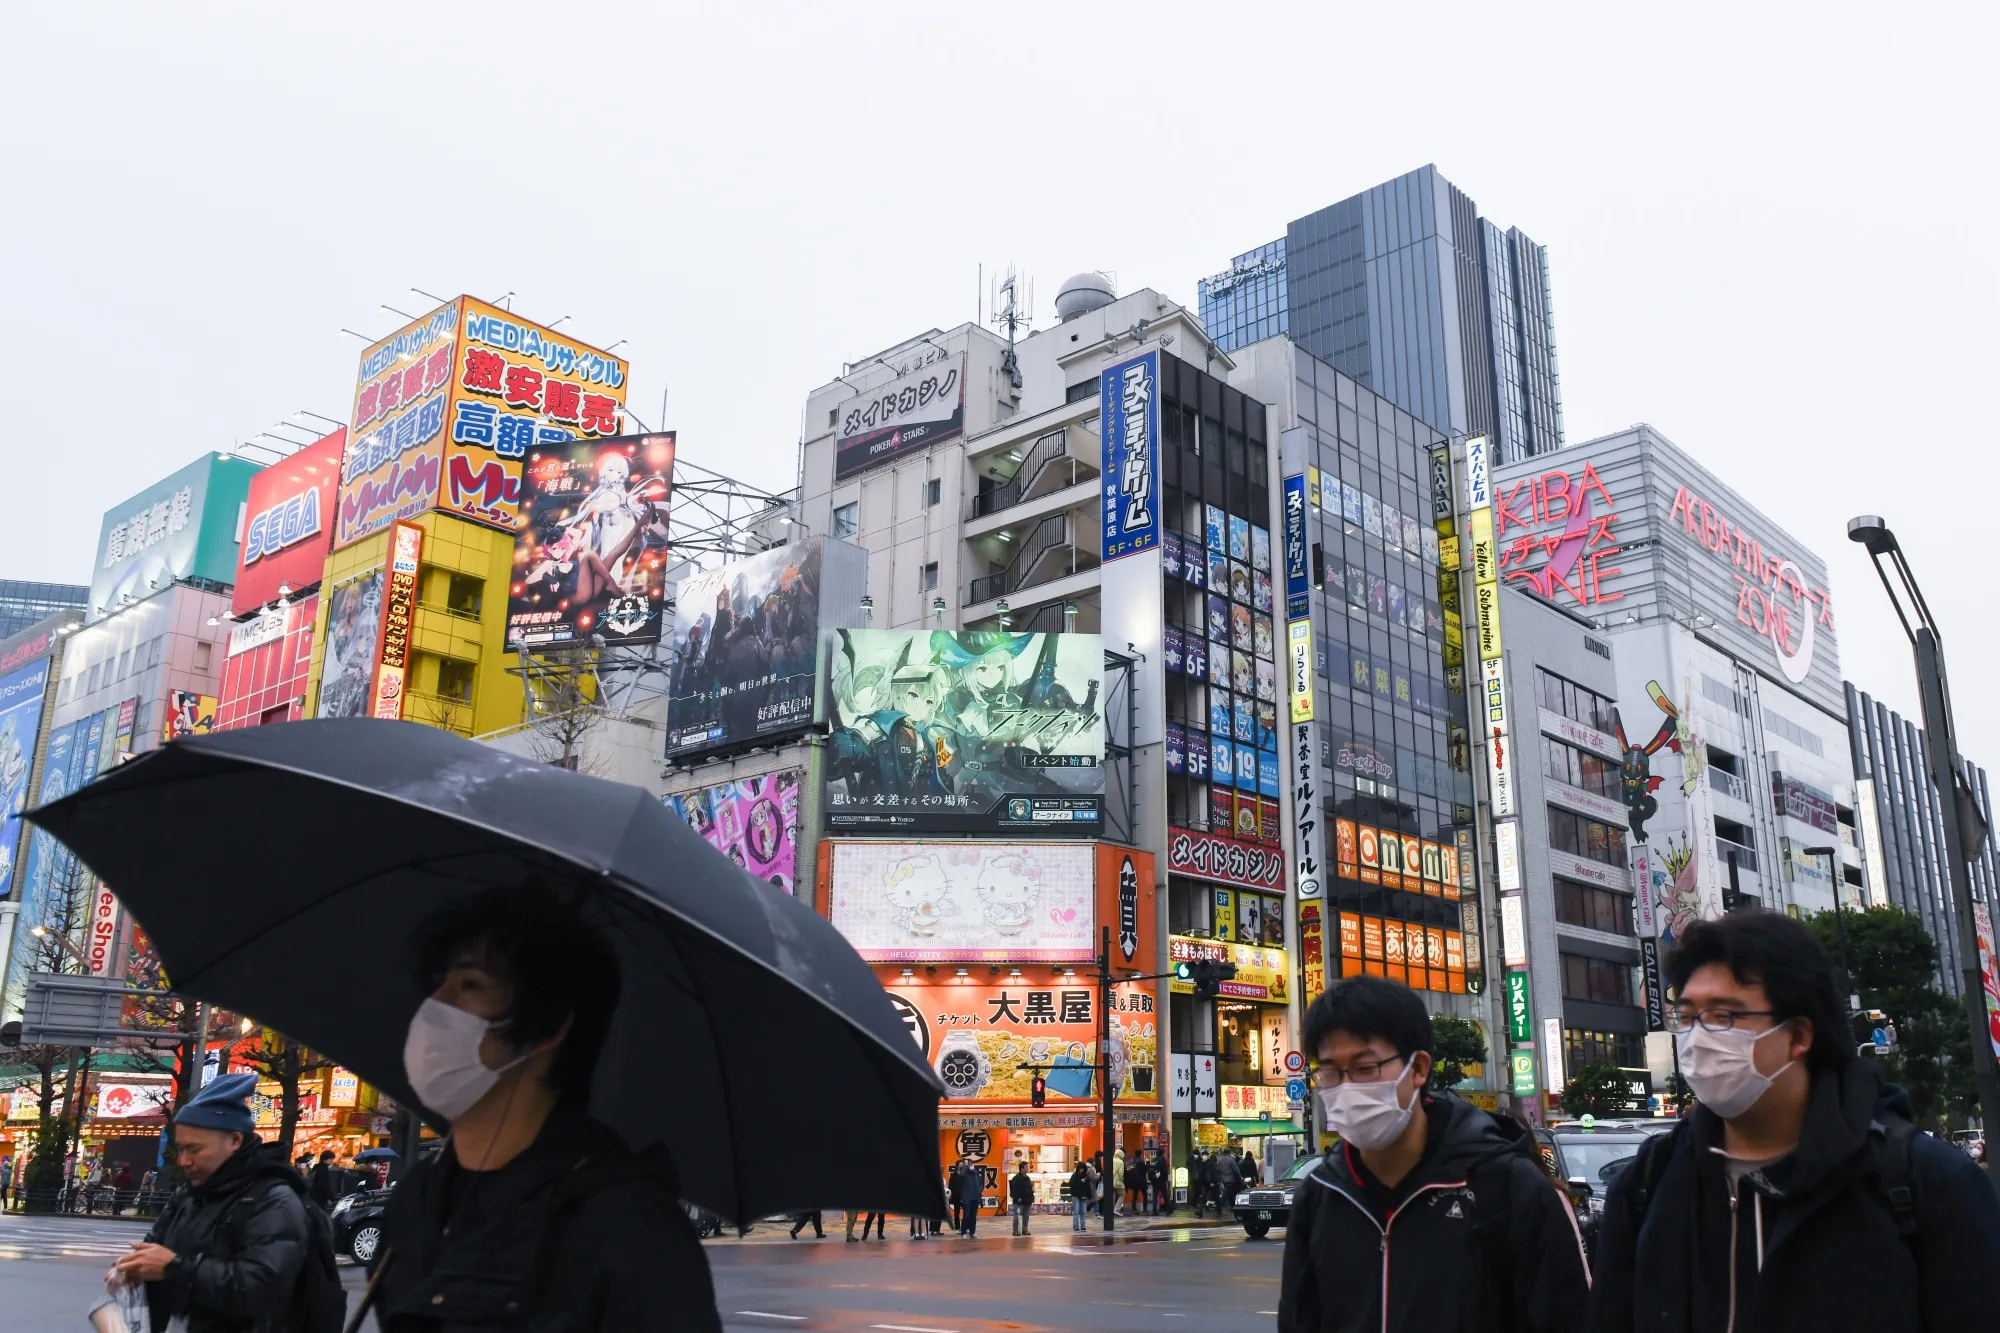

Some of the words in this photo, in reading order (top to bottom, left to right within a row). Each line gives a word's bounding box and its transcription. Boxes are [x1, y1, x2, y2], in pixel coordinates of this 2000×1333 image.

[360, 302, 459, 385] MEDIAリサイクル
[466, 310, 624, 388] MEDIAリサイクル
[355, 340, 454, 432] 激安販売
[461, 347, 621, 436] 激安販売
[844, 369, 957, 437] メイドカジノ
[346, 391, 447, 484] 高額買取
[869, 439, 891, 455] POKER
[902, 426, 925, 441] STARS
[1471, 443, 1487, 504] スーパービル
[341, 454, 440, 541] Mulan
[1106, 484, 1117, 538] 秋葉原店
[244, 487, 322, 566] SEGA
[1475, 540, 1488, 580] Yellow
[393, 573, 414, 586] DVD
[1185, 561, 1204, 585] 7F
[390, 593, 411, 606] ゲーム
[392, 605, 407, 615] CD
[510, 611, 563, 625] 好評配信中
[1733, 573, 1797, 657] ZONE
[386, 623, 408, 636] アニメ
[387, 614, 408, 626] アイドル
[1479, 588, 1493, 653] Submarine
[385, 634, 406, 647] コミック
[1294, 626, 1306, 637] 3F
[385, 645, 404, 656] ホビー
[1187, 654, 1206, 678] 6F
[1297, 645, 1306, 692] りらくる
[1487, 660, 1498, 669] 5F
[757, 695, 812, 722] 好評配信中
[1029, 756, 1092, 766] イベント始動
[1188, 751, 1208, 775] 5F
[831, 793, 979, 807] 思いが交差するその場所へ
[1213, 815, 1231, 827] Stars
[1172, 834, 1282, 886] メイドカジノ
[1574, 863, 1595, 879] @home
[1641, 872, 1650, 905] @home
[1218, 894, 1228, 905] 3F
[1216, 908, 1231, 921] 入口
[1342, 931, 1356, 941] Tax
[91, 921, 113, 972] Shop
[1172, 941, 1227, 963] 全身もみほぐし
[1342, 942, 1358, 953] Free
[1235, 955, 1249, 965] No.1
[1251, 958, 1264, 968] No.1
[1236, 972, 1254, 982] 24:00
[1643, 941, 1662, 1029] GALLERIA
[937, 1013, 981, 1026] チケット
[987, 990, 1093, 1025] 大黒屋
[1511, 976, 1526, 1037] リバティー
[1271, 1027, 1282, 1076] ルノアール
[1289, 1056, 1301, 1067] 40
[1520, 1059, 1529, 1071] P
[333, 1077, 357, 1089] AKIBA
[1176, 1086, 1214, 1099] ルノアール
[1290, 1085, 1299, 1098] P
[1225, 1086, 1257, 1110] 免税
[1259, 1087, 1271, 1104] TAX
[1056, 1113, 1096, 1127] 無料査定
[959, 1131, 988, 1159] 質
[1213, 1133, 1225, 1144] 22
